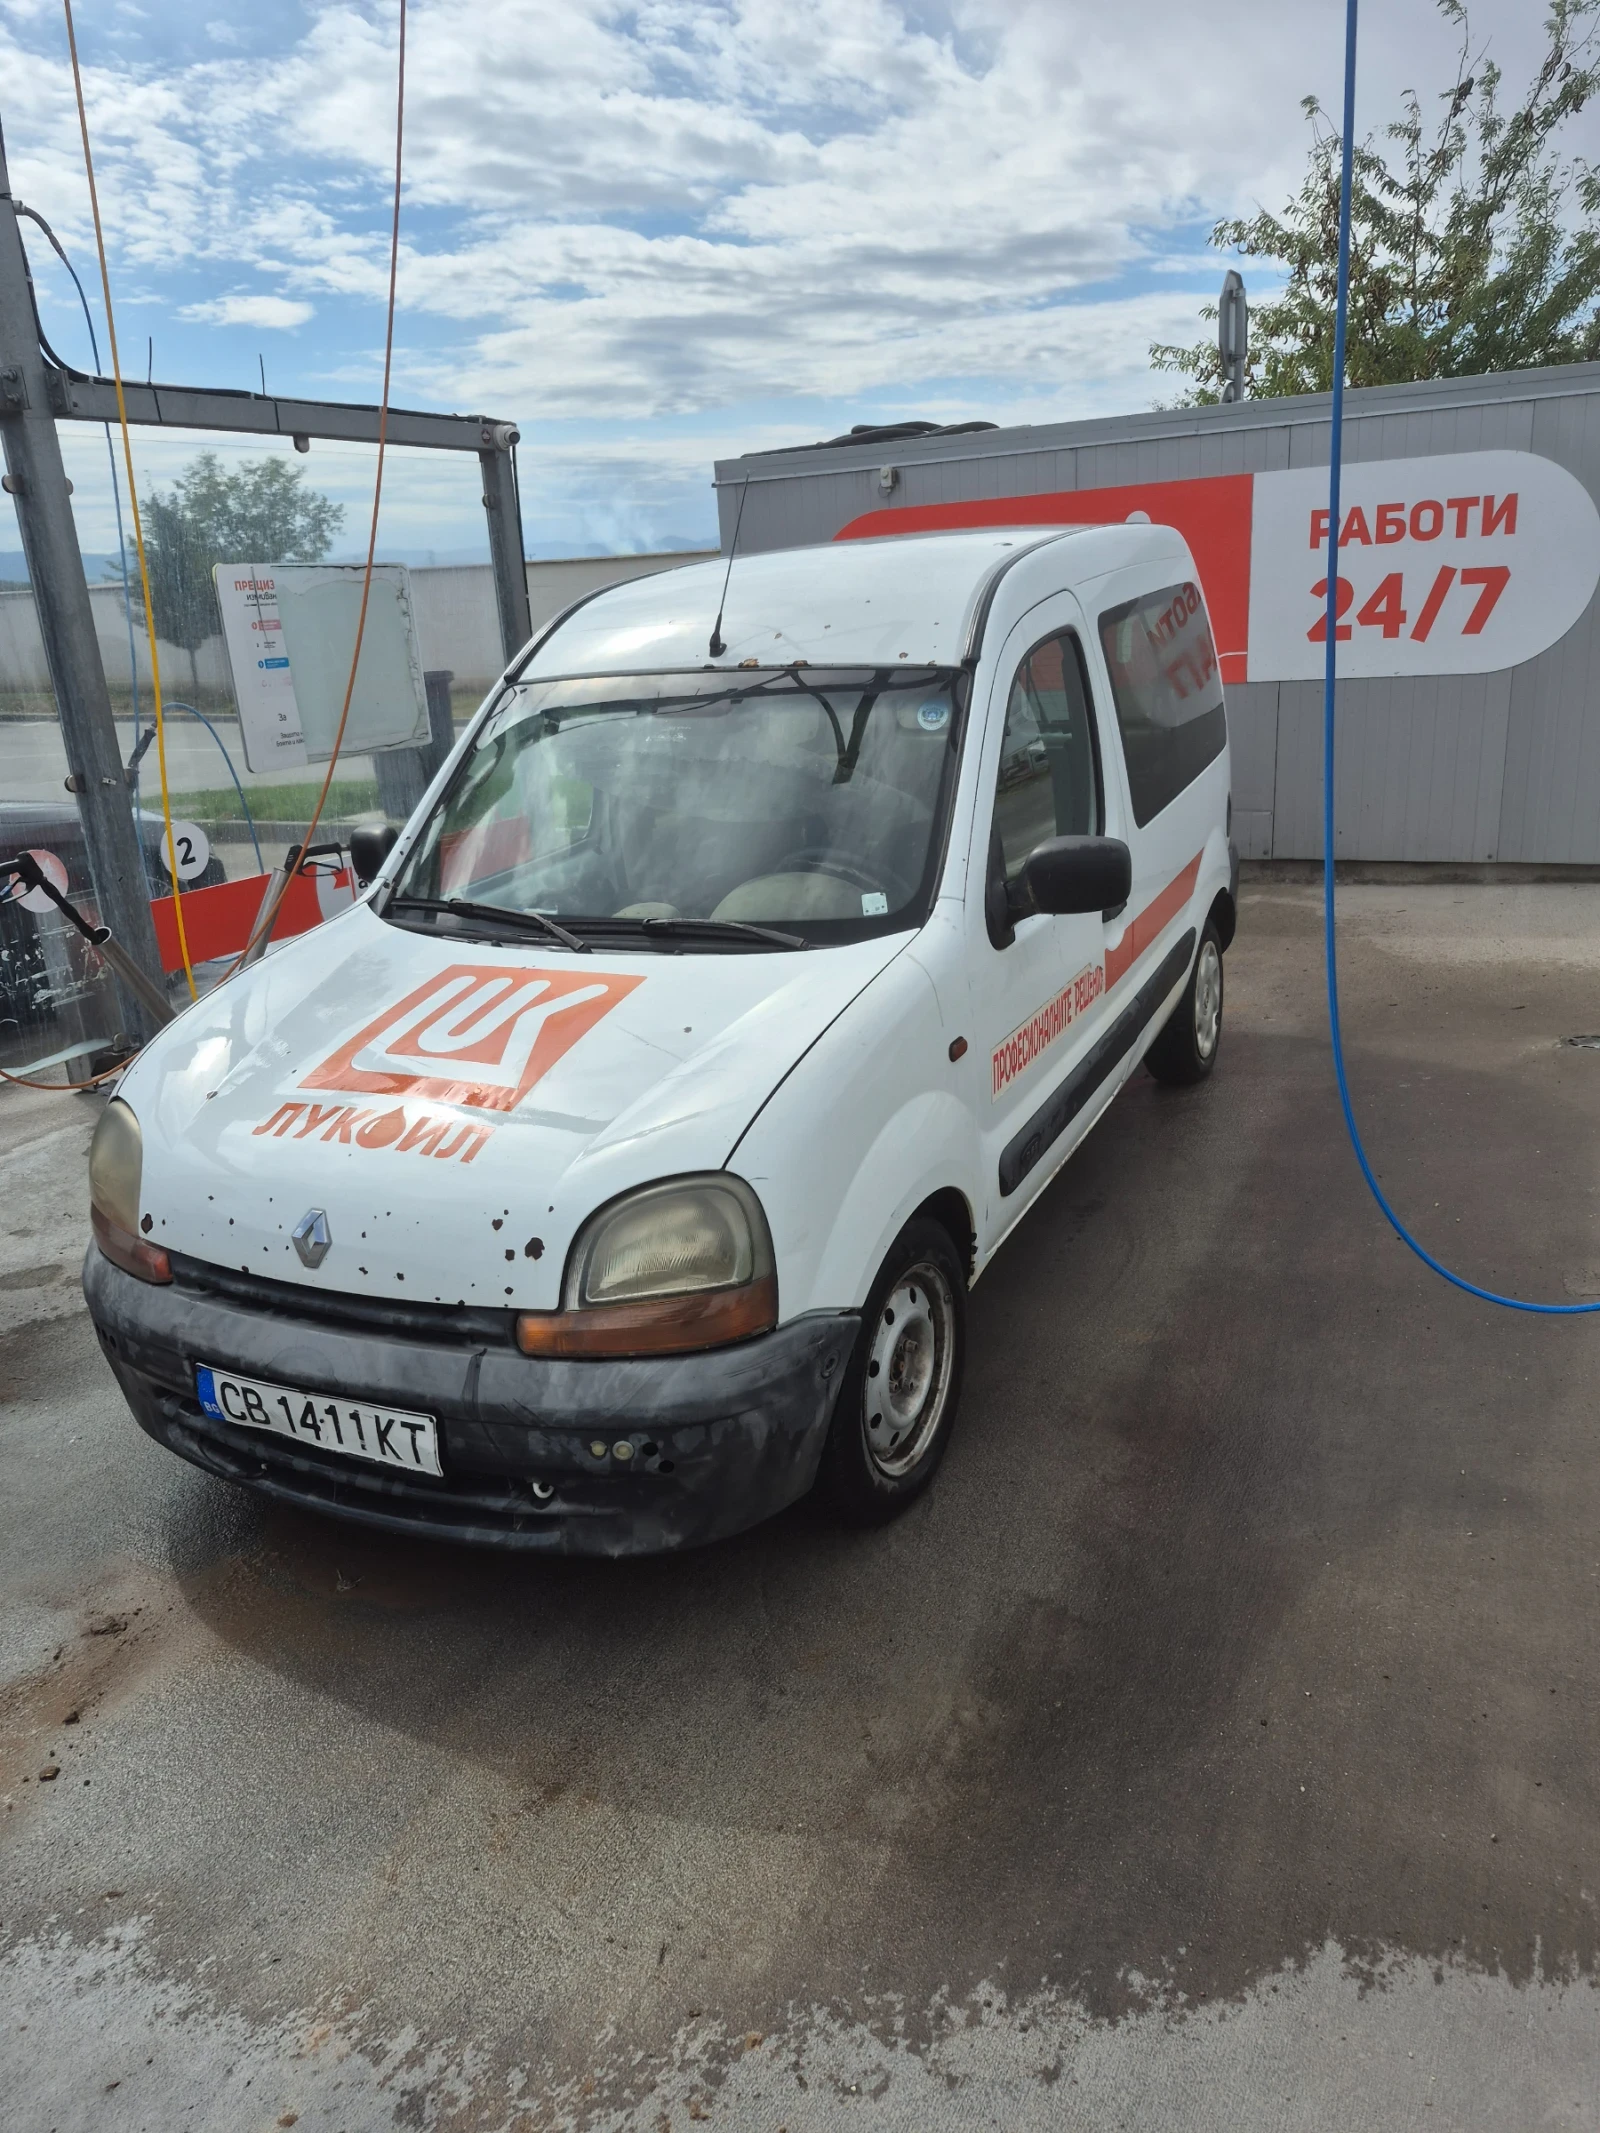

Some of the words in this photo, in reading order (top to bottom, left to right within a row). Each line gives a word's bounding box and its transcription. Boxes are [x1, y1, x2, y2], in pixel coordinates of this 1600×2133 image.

[1309, 492, 1519, 549] РАБОТИ
[1306, 564, 1511, 643] 24/7
[177, 836, 196, 866] 2
[993, 987, 1072, 1094] ПРОФЕСИОНАЛНИТЕ
[252, 1102, 496, 1163] ЛУКОИЛ
[203, 1401, 220, 1414] BG
